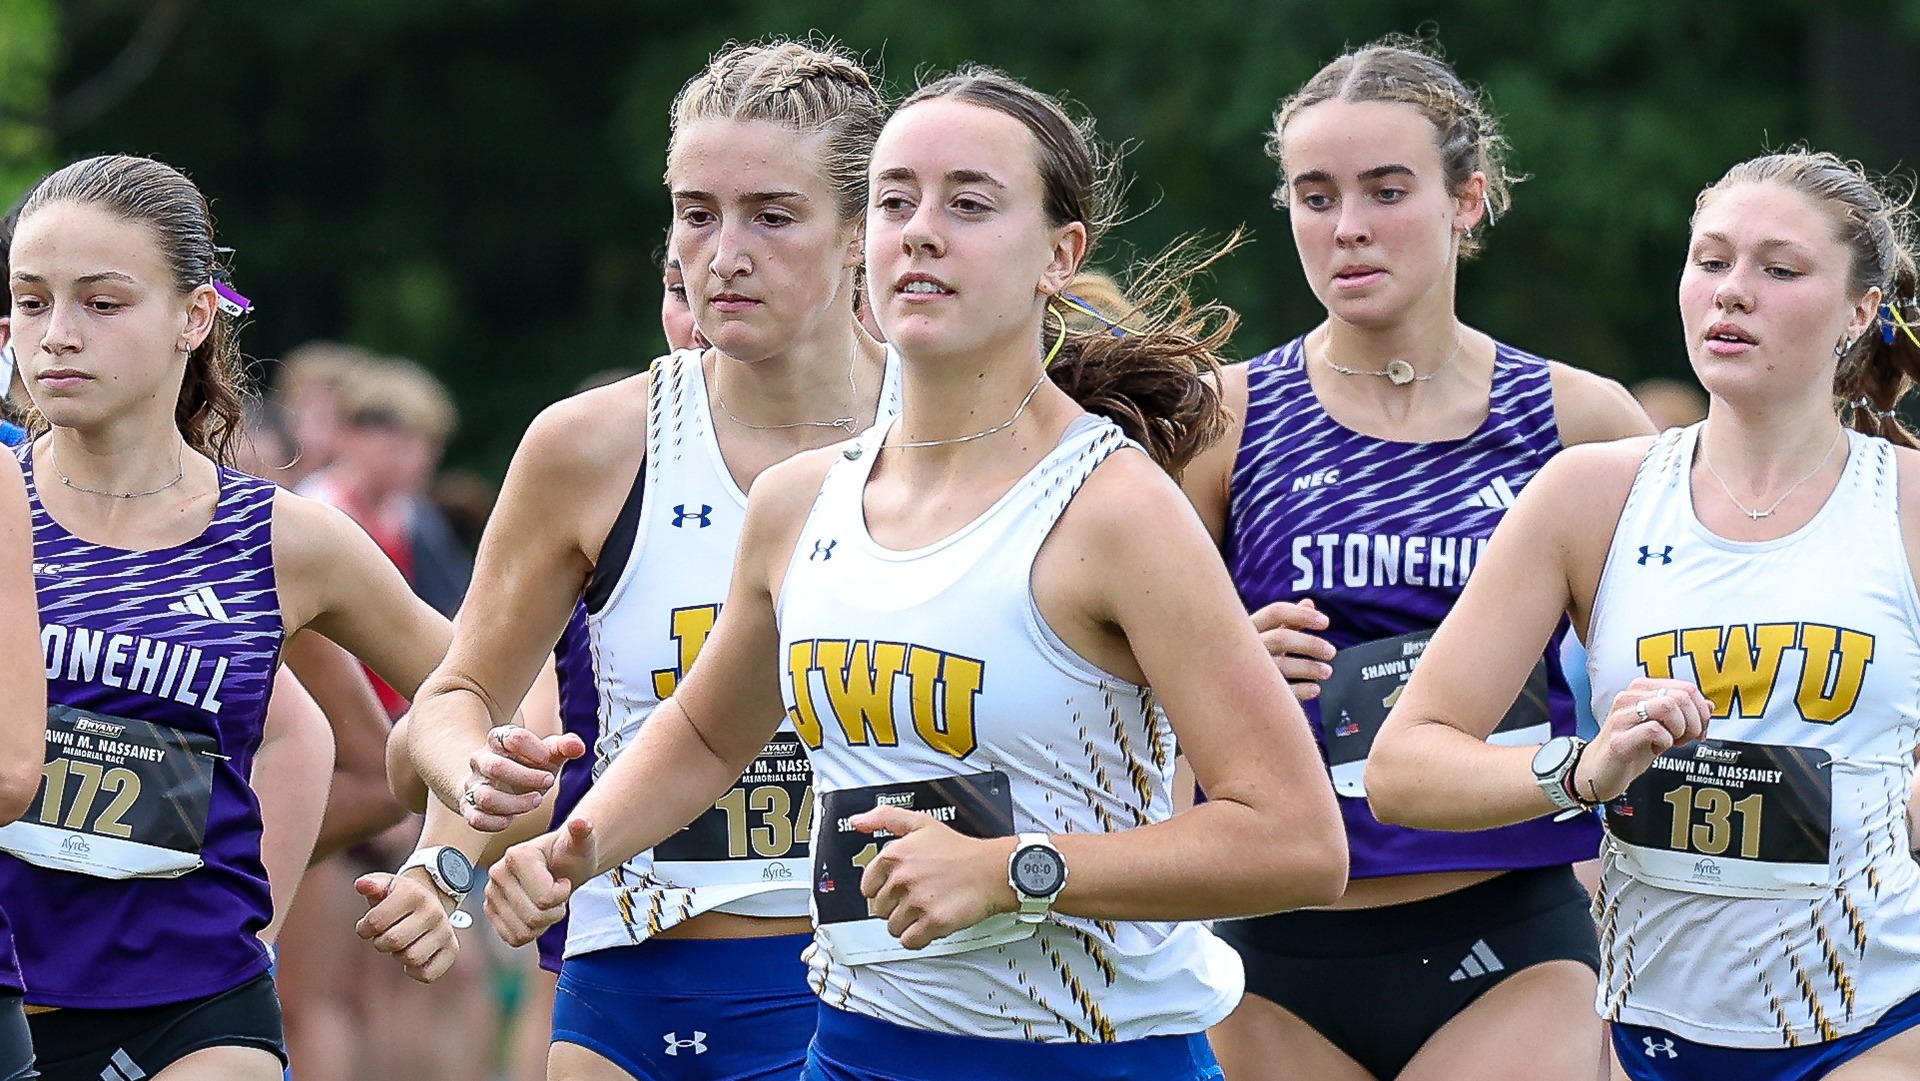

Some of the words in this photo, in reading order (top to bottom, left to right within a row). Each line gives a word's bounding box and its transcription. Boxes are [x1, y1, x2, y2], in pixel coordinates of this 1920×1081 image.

[1291, 469, 1340, 492] NEC
[1291, 532, 1488, 593] STONEHI
[41, 623, 229, 714] ONEHILL
[1361, 661, 1407, 681] SHAWN
[788, 638, 985, 760] JWU
[75, 717, 122, 735] BRYANT
[45, 730, 74, 746] AWN
[77, 737, 93, 750] M.
[98, 739, 166, 763] NASSANEY
[62, 747, 103, 761] MEMORIAL
[105, 755, 125, 765] RACE
[1696, 746, 1737, 760] BRYANT
[755, 760, 772, 774] M.
[777, 759, 813, 773] NASS
[1651, 756, 1694, 773] SHAWN
[1698, 762, 1714, 777] M.
[1718, 766, 1782, 784] NASSANEY
[742, 774, 784, 783] MEMORIAL
[787, 773, 806, 782] RACE
[1686, 774, 1724, 786] MEMORIAL
[1725, 779, 1744, 789] RACE
[40, 757, 141, 838] 172
[1664, 784, 1763, 858] 131
[61, 834, 91, 852] Ayres
[762, 861, 793, 880] Ayres
[1693, 859, 1721, 876] Ayres
